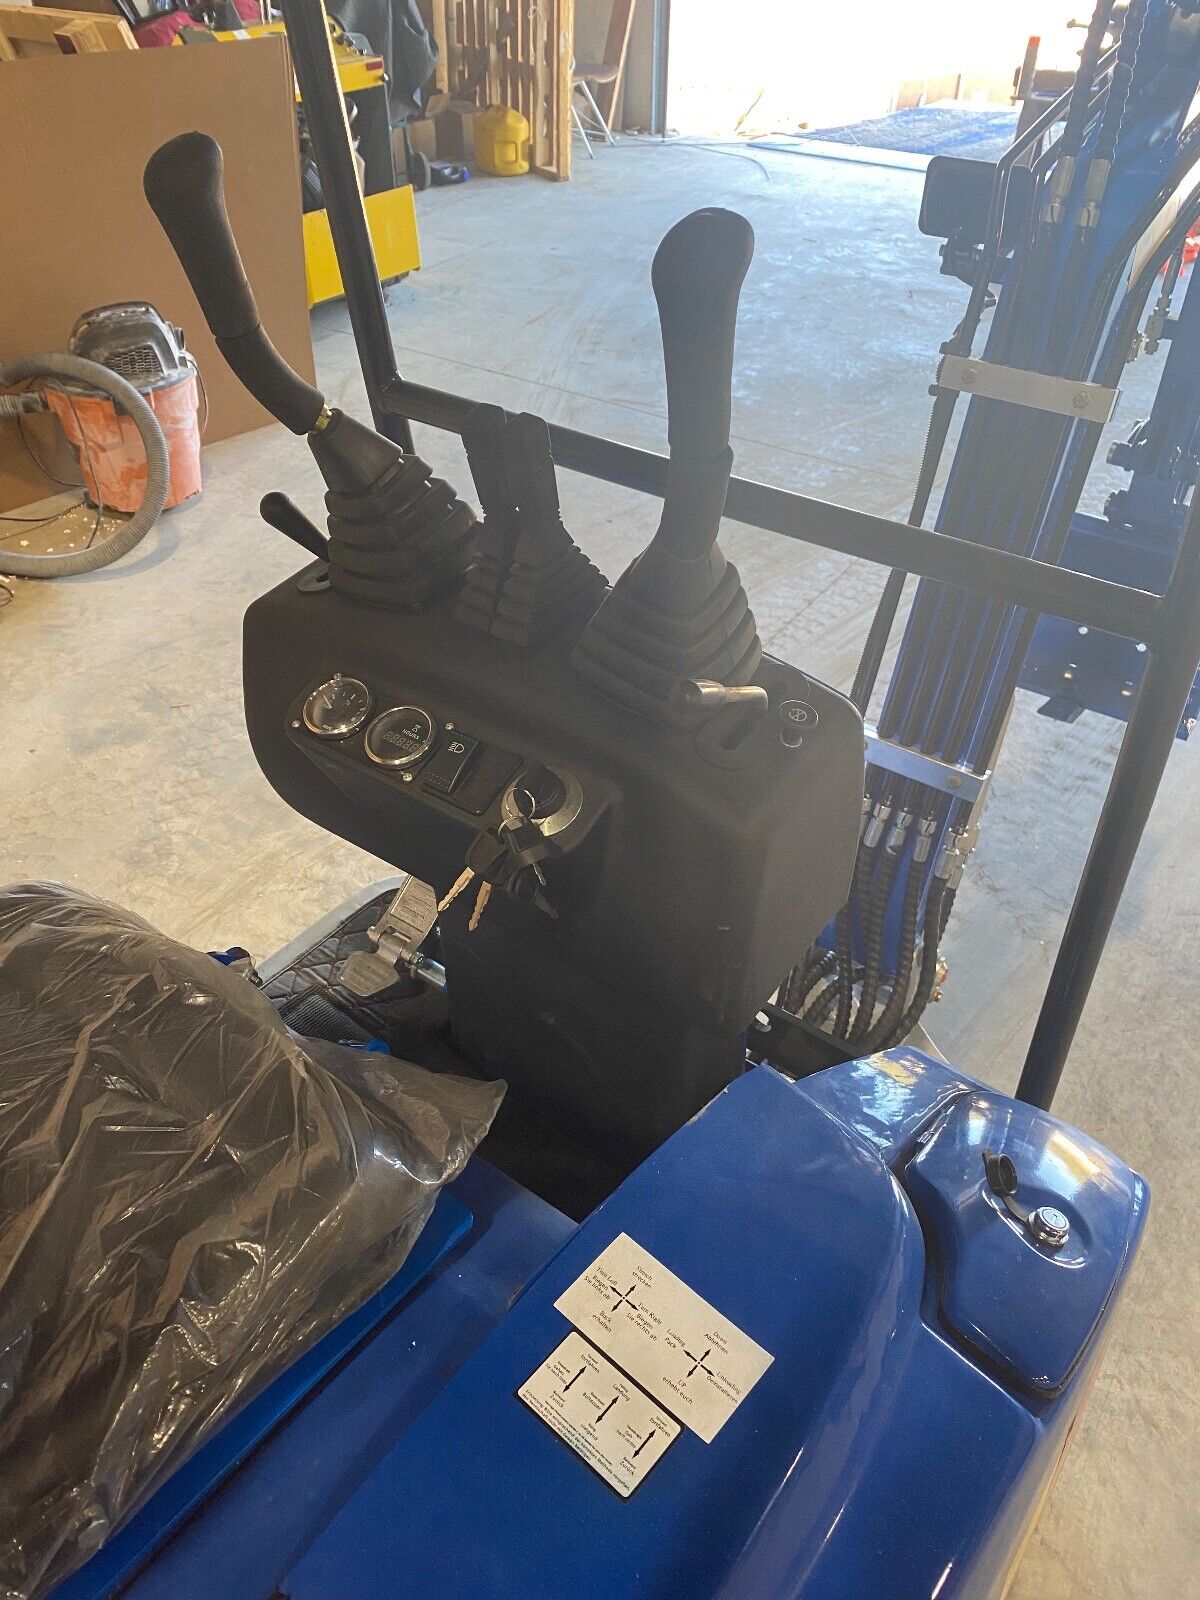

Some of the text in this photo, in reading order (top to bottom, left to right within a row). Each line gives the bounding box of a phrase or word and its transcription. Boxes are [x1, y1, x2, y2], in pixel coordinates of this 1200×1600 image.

[592, 1274, 611, 1291] Biegen
[596, 1266, 618, 1286] Turn Left
[631, 1271, 652, 1289] strecken
[583, 1275, 611, 1300] Sie links ab
[599, 1310, 612, 1324] Back
[635, 1312, 653, 1329] Biegen
[637, 1301, 662, 1325] Turn Right
[592, 1314, 612, 1333] erhalten
[626, 1312, 635, 1321] Sie
[633, 1320, 650, 1335] rechts
[664, 1336, 676, 1349] Pack
[712, 1330, 727, 1345] Down
[677, 1379, 687, 1387] UP
[716, 1371, 742, 1396] Unloading
[679, 1391, 693, 1404] euch
[619, 1460, 635, 1476] Zurück
